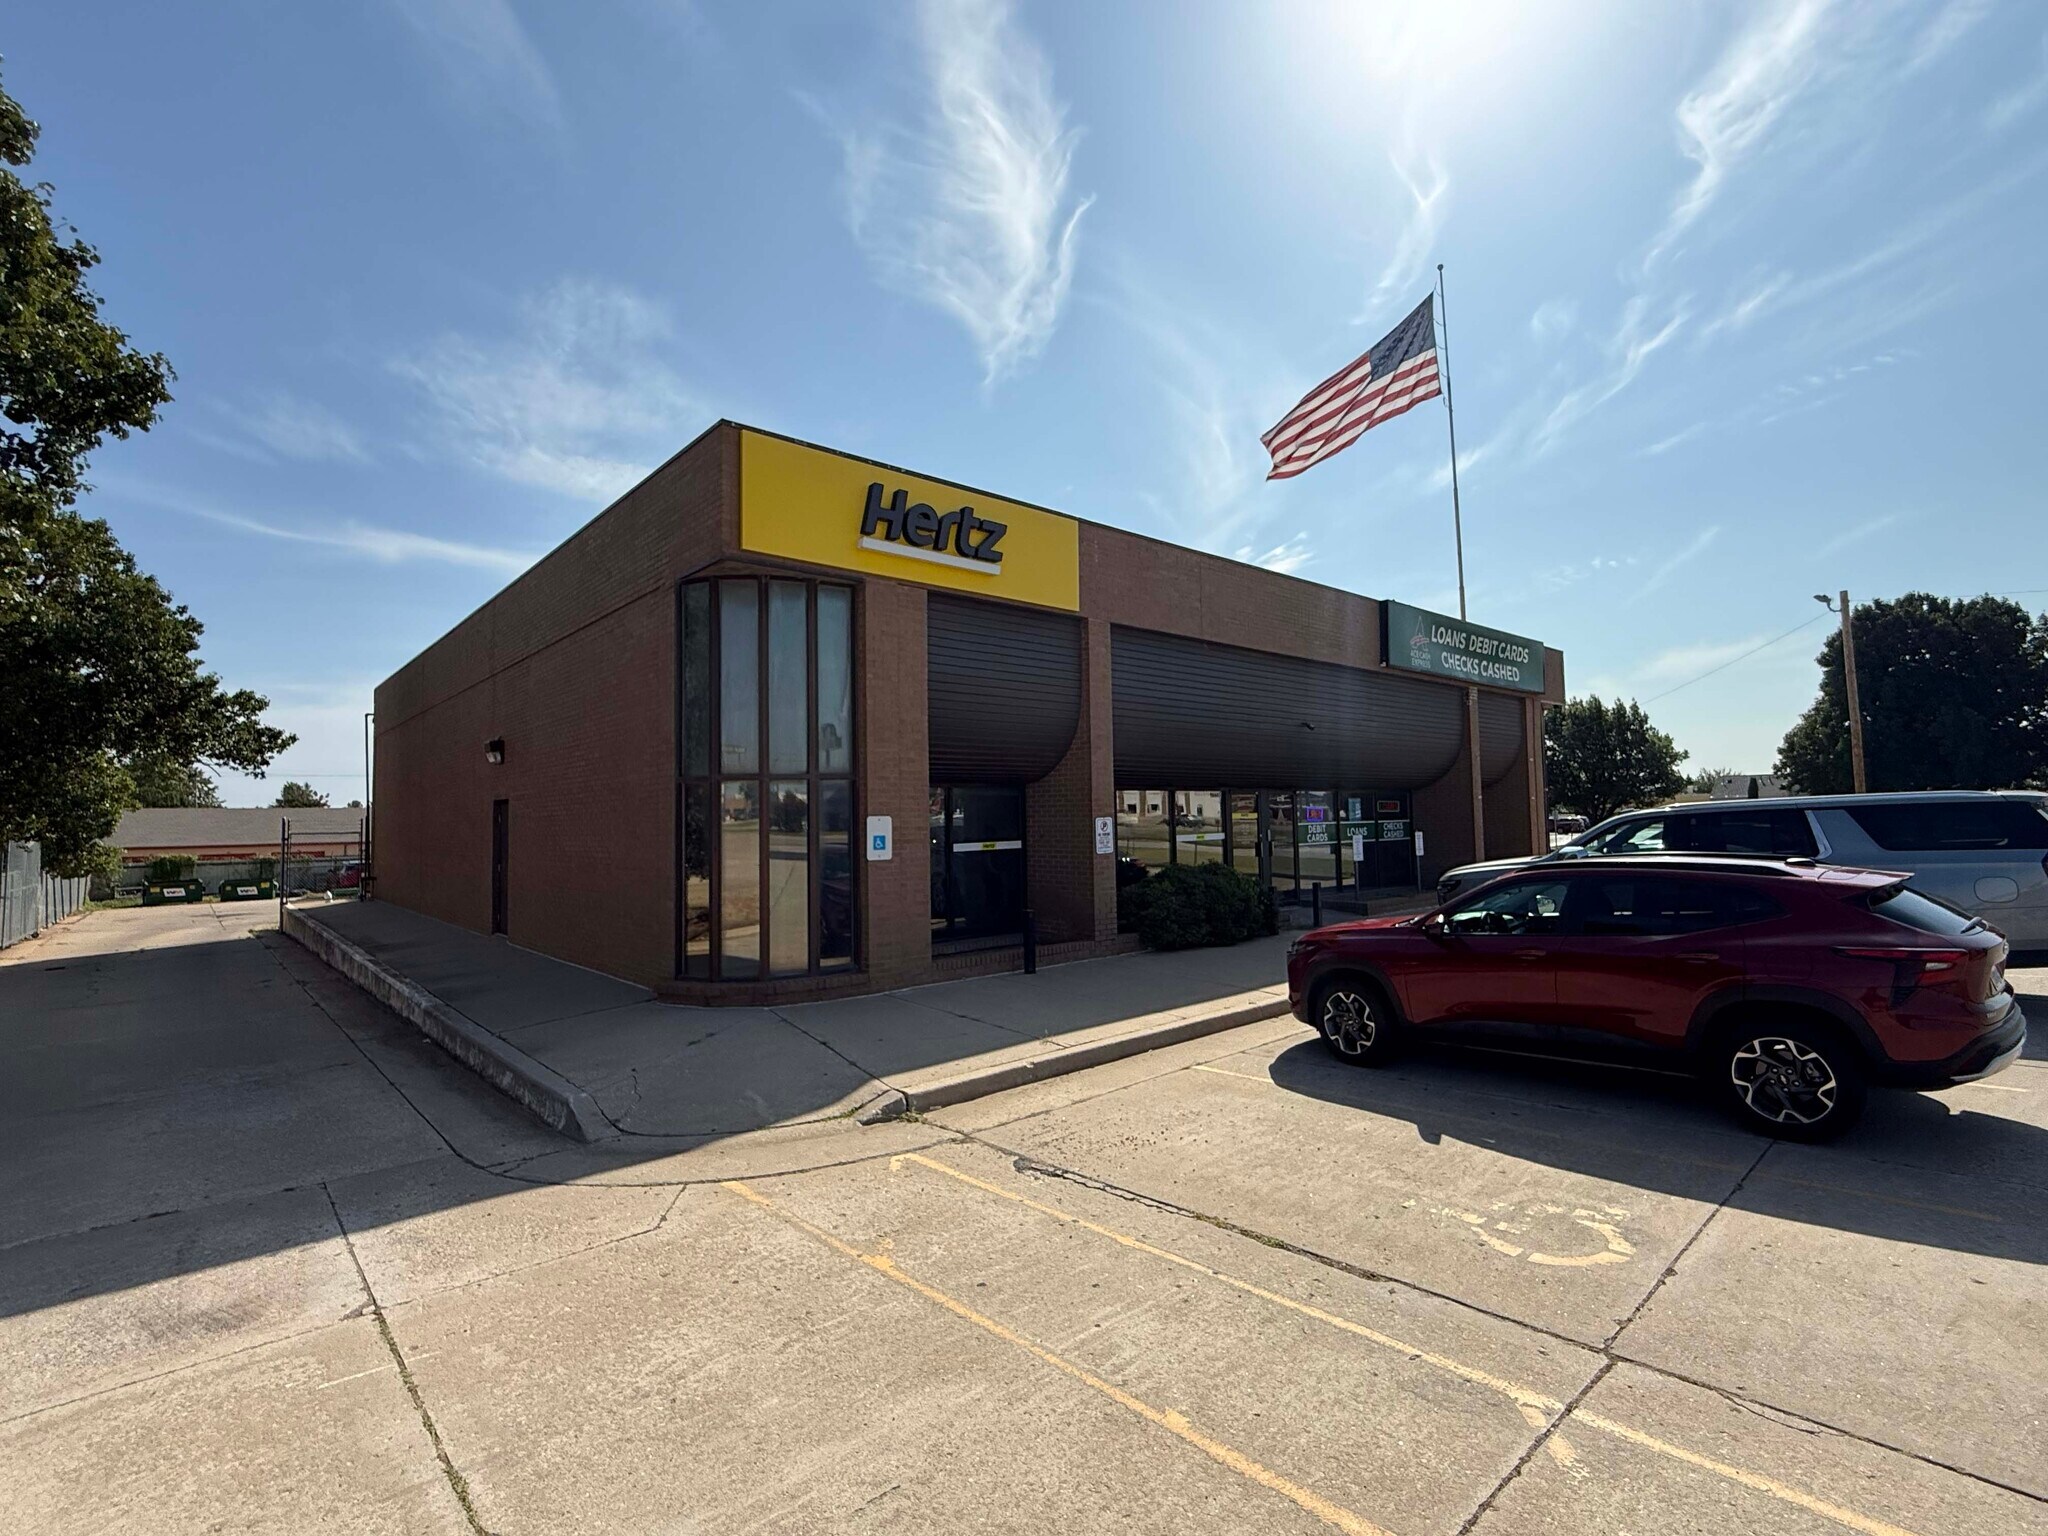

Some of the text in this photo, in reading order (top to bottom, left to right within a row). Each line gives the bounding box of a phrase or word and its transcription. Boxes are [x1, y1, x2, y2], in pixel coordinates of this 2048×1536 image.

[860, 482, 1007, 562] Hertz
[1431, 625, 1529, 663] LOANS DEBIT CARDS
[1411, 658, 1431, 669] EXPRESS
[1441, 651, 1520, 682] CHECKS CASHED
[1308, 824, 1326, 834] DEBIT
[1383, 822, 1403, 830] CHECKS
[1347, 827, 1368, 837] LOANS
[1383, 830, 1404, 838] CASHED
[1307, 834, 1328, 842] CARDS
